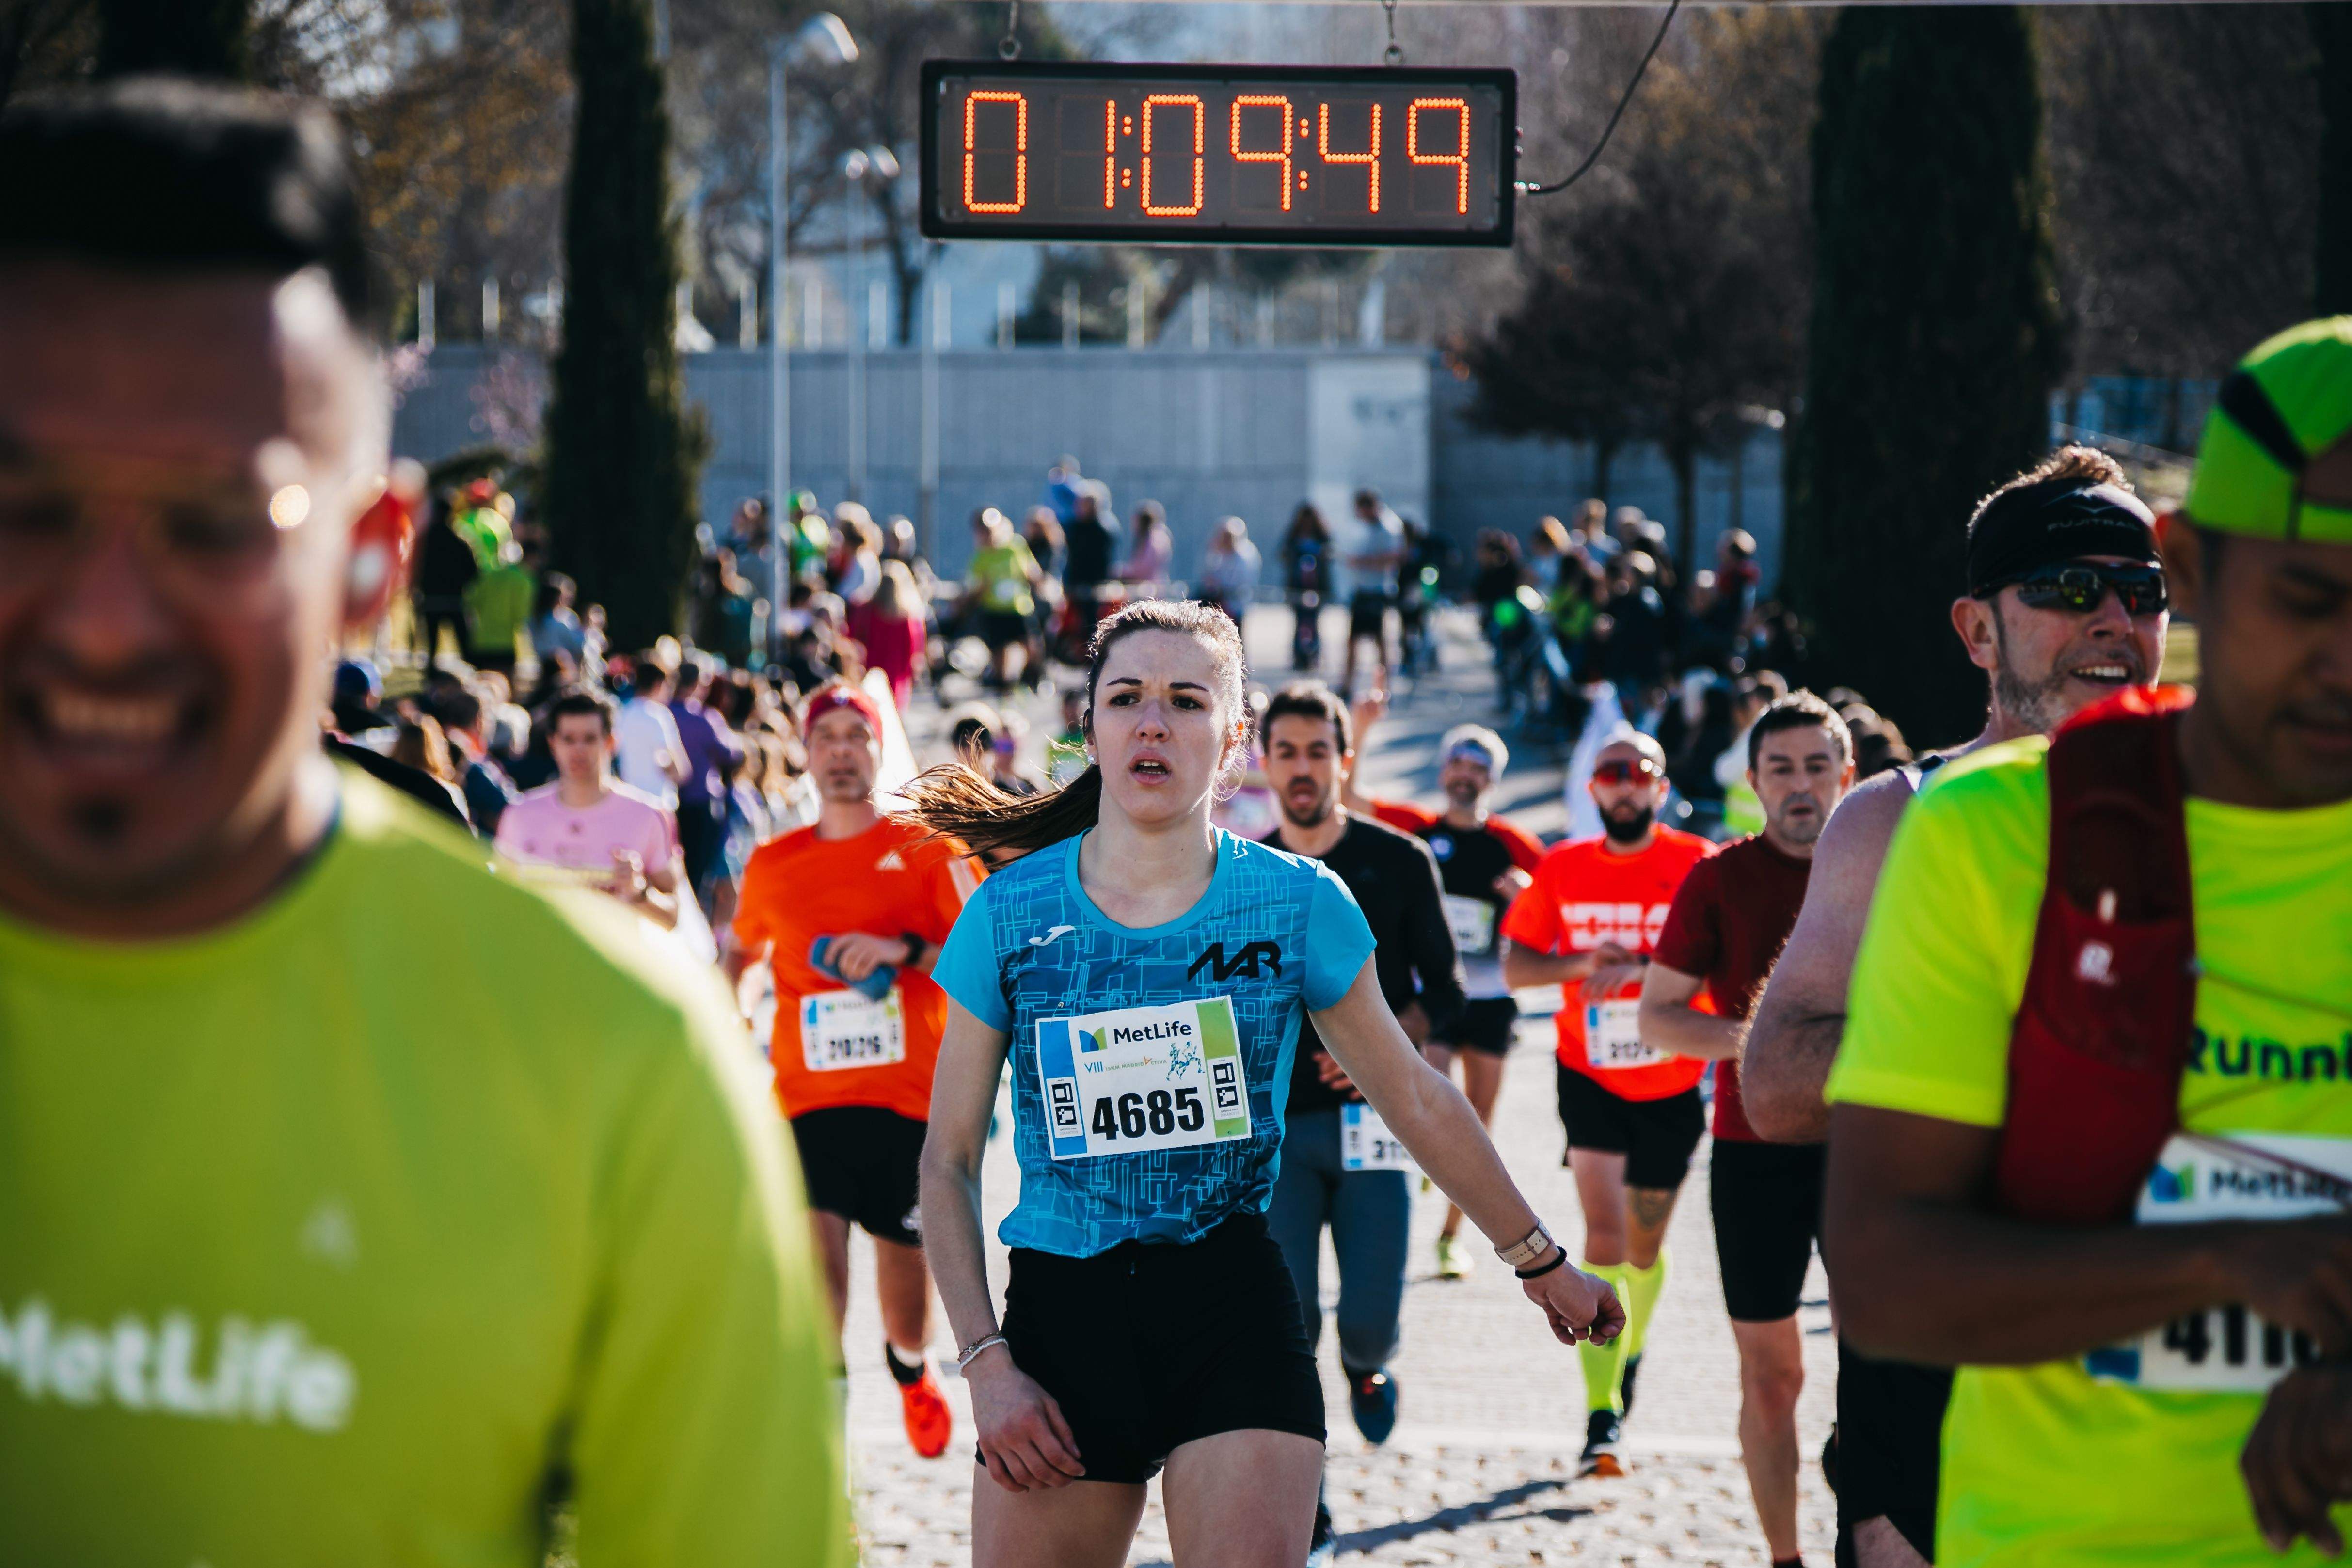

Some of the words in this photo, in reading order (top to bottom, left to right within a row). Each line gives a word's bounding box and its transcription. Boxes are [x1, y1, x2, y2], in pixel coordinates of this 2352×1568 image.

[1114, 1020, 1192, 1045] MetLife
[1084, 1061, 1103, 1073] VIII
[1092, 1087, 1205, 1141] 4685
